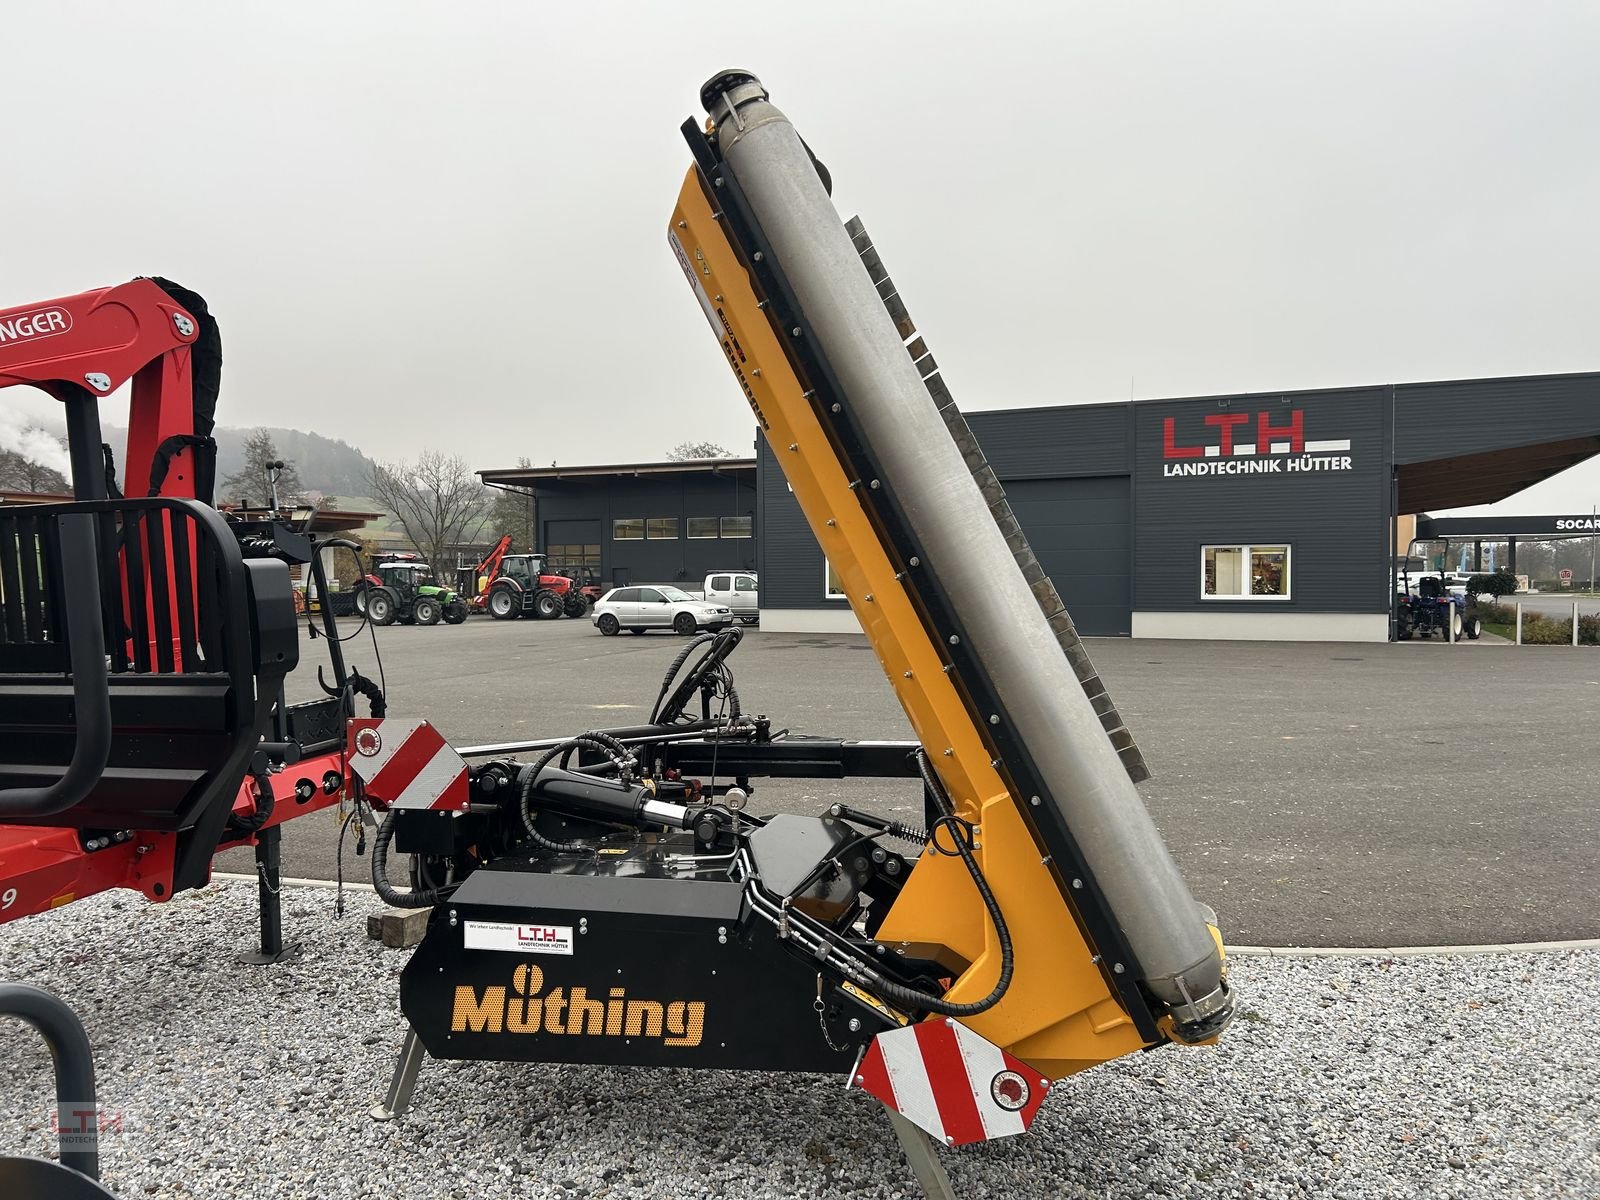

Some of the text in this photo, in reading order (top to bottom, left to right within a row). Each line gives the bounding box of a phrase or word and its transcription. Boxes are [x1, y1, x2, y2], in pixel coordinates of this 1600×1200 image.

[1163, 454, 1352, 477] LANDTECHNIK HÜTTER
[1556, 519, 1600, 530] SOCAR
[2, 888, 17, 910] 9
[451, 963, 706, 1047] Müthing
